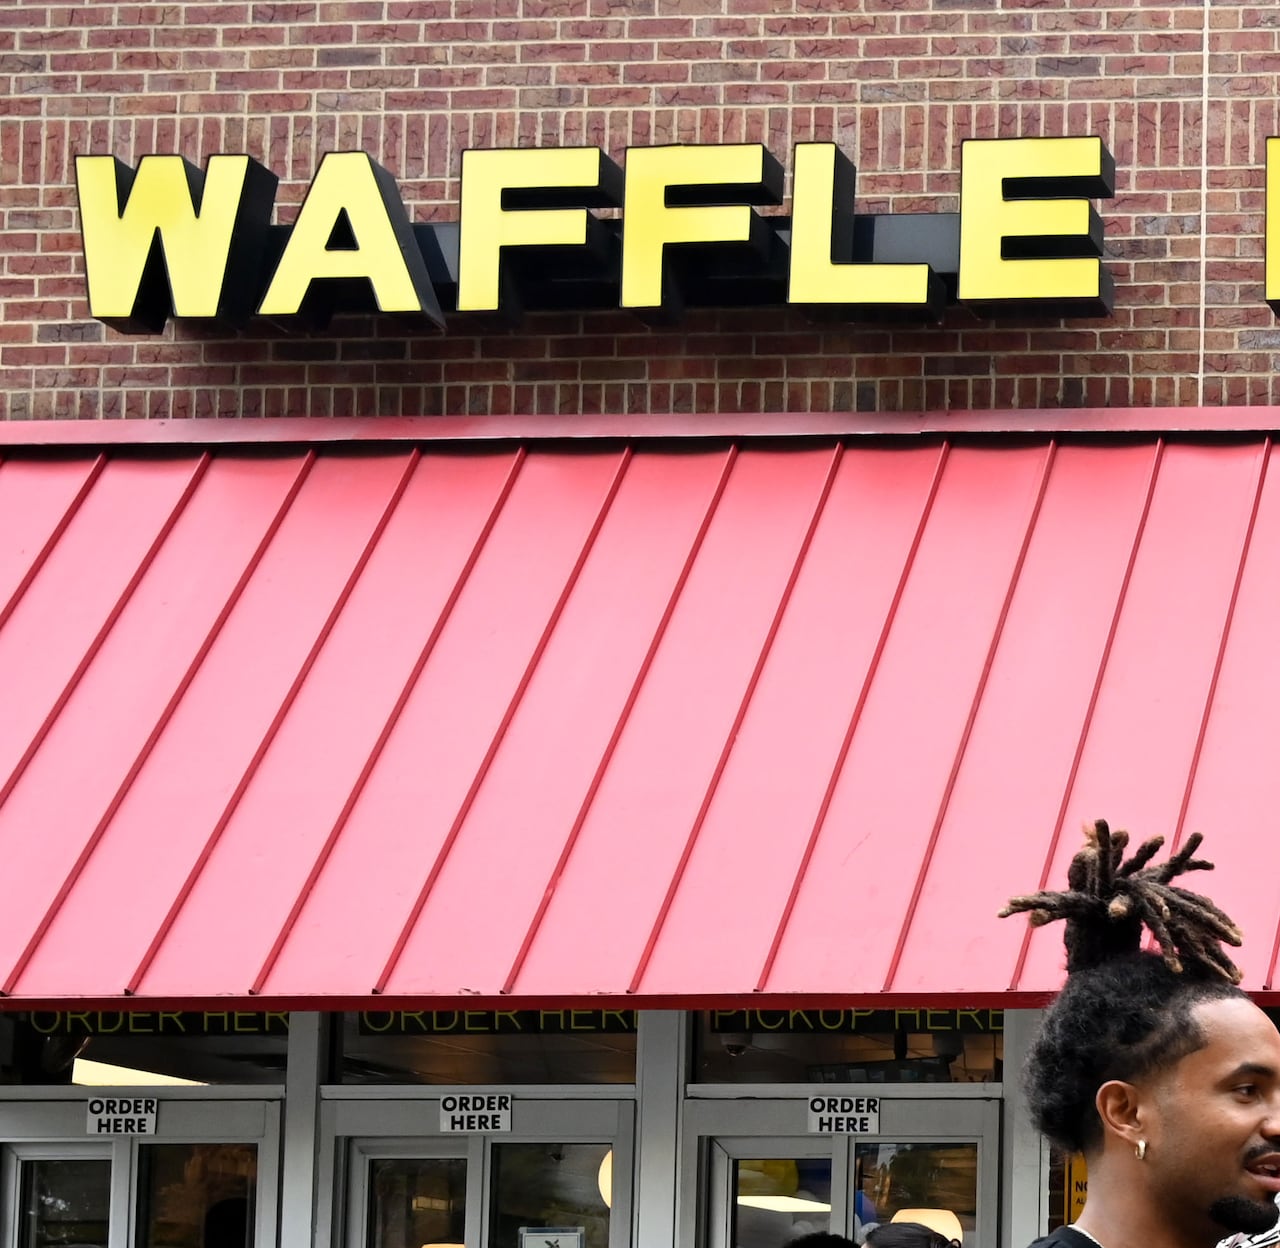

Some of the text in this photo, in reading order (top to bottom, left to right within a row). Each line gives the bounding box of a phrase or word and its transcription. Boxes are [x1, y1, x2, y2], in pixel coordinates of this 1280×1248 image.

[75, 136, 1106, 320] WAFFLE
[30, 1011, 186, 1033] ORDER
[362, 1010, 522, 1032] ORDER
[713, 1009, 875, 1030] PICKUP
[89, 1099, 155, 1115] ORDER
[442, 1095, 510, 1111] ORDER
[809, 1097, 878, 1114] ORDER
[97, 1118, 147, 1134] HERE
[450, 1114, 501, 1130] HERE
[818, 1117, 869, 1132] HERE
